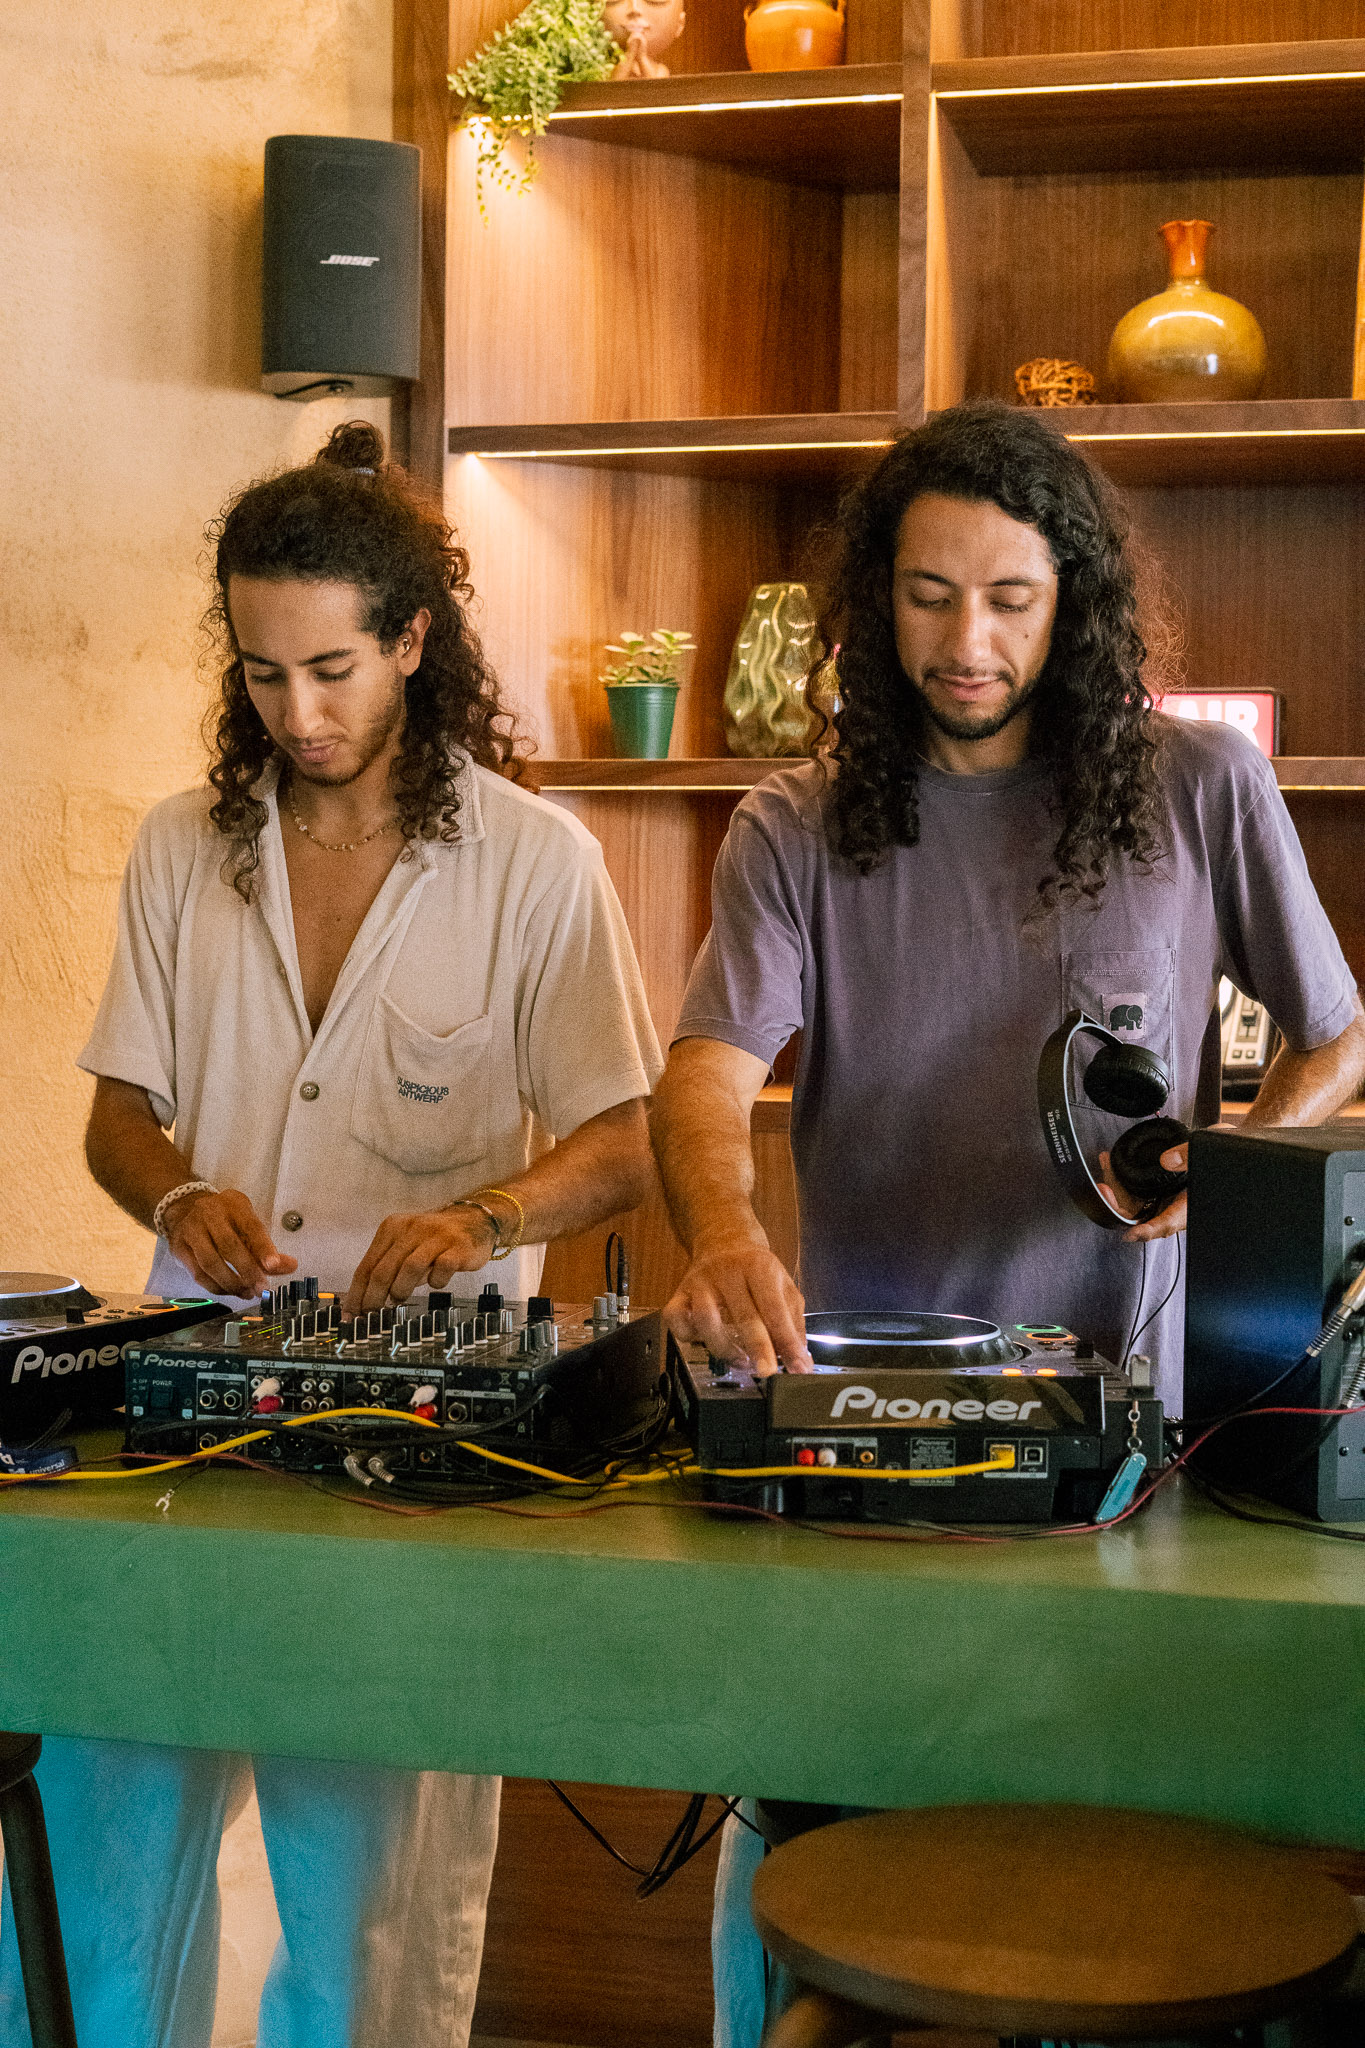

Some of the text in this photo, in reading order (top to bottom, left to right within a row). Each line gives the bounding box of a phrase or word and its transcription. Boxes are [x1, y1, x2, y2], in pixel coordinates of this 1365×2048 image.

[397, 1076, 449, 1096] SUSPICIOUS
[398, 1087, 444, 1103] ANTWERP
[1047, 1111, 1067, 1163] SENNHEISER
[11, 1341, 142, 1384] Pione
[143, 1353, 217, 1369] Pioneer
[829, 1385, 1043, 1421] Pioneer
